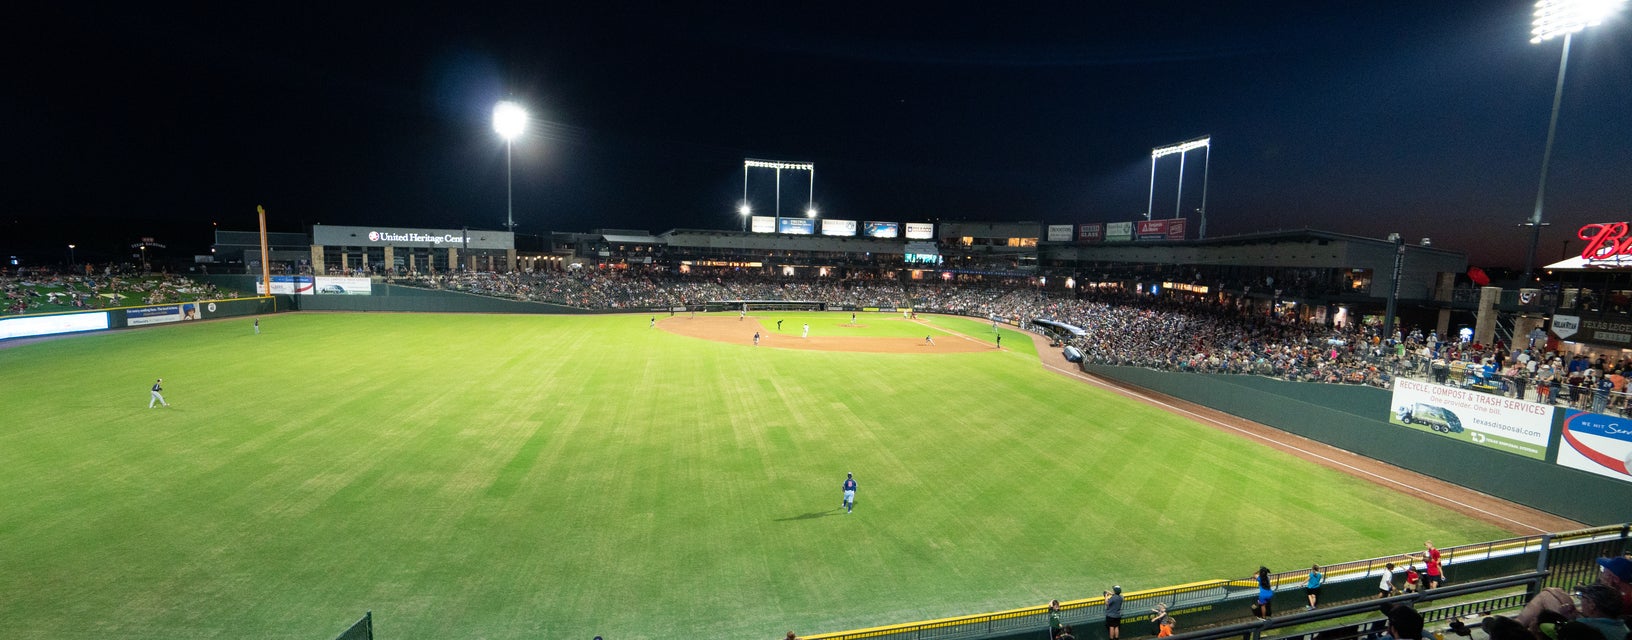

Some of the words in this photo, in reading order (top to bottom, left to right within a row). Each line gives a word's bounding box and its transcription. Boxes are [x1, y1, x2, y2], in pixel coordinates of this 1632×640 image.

[380, 232, 408, 242] United
[409, 233, 444, 244] Heritage
[444, 234, 471, 243] Centr
[1583, 320, 1608, 330] TEXAS
[1400, 380, 1430, 394] RECYCLE,
[1432, 386, 1467, 399] COMPOST
[1468, 393, 1473, 401] &
[1476, 394, 1502, 407] TRASH
[1504, 399, 1546, 416] SERVICES
[1430, 395, 1443, 403] One
[1443, 399, 1472, 409] provider.
[1473, 404, 1488, 412] One
[1488, 407, 1502, 415] bill.
[1472, 417, 1541, 438] texasdisposal.com
